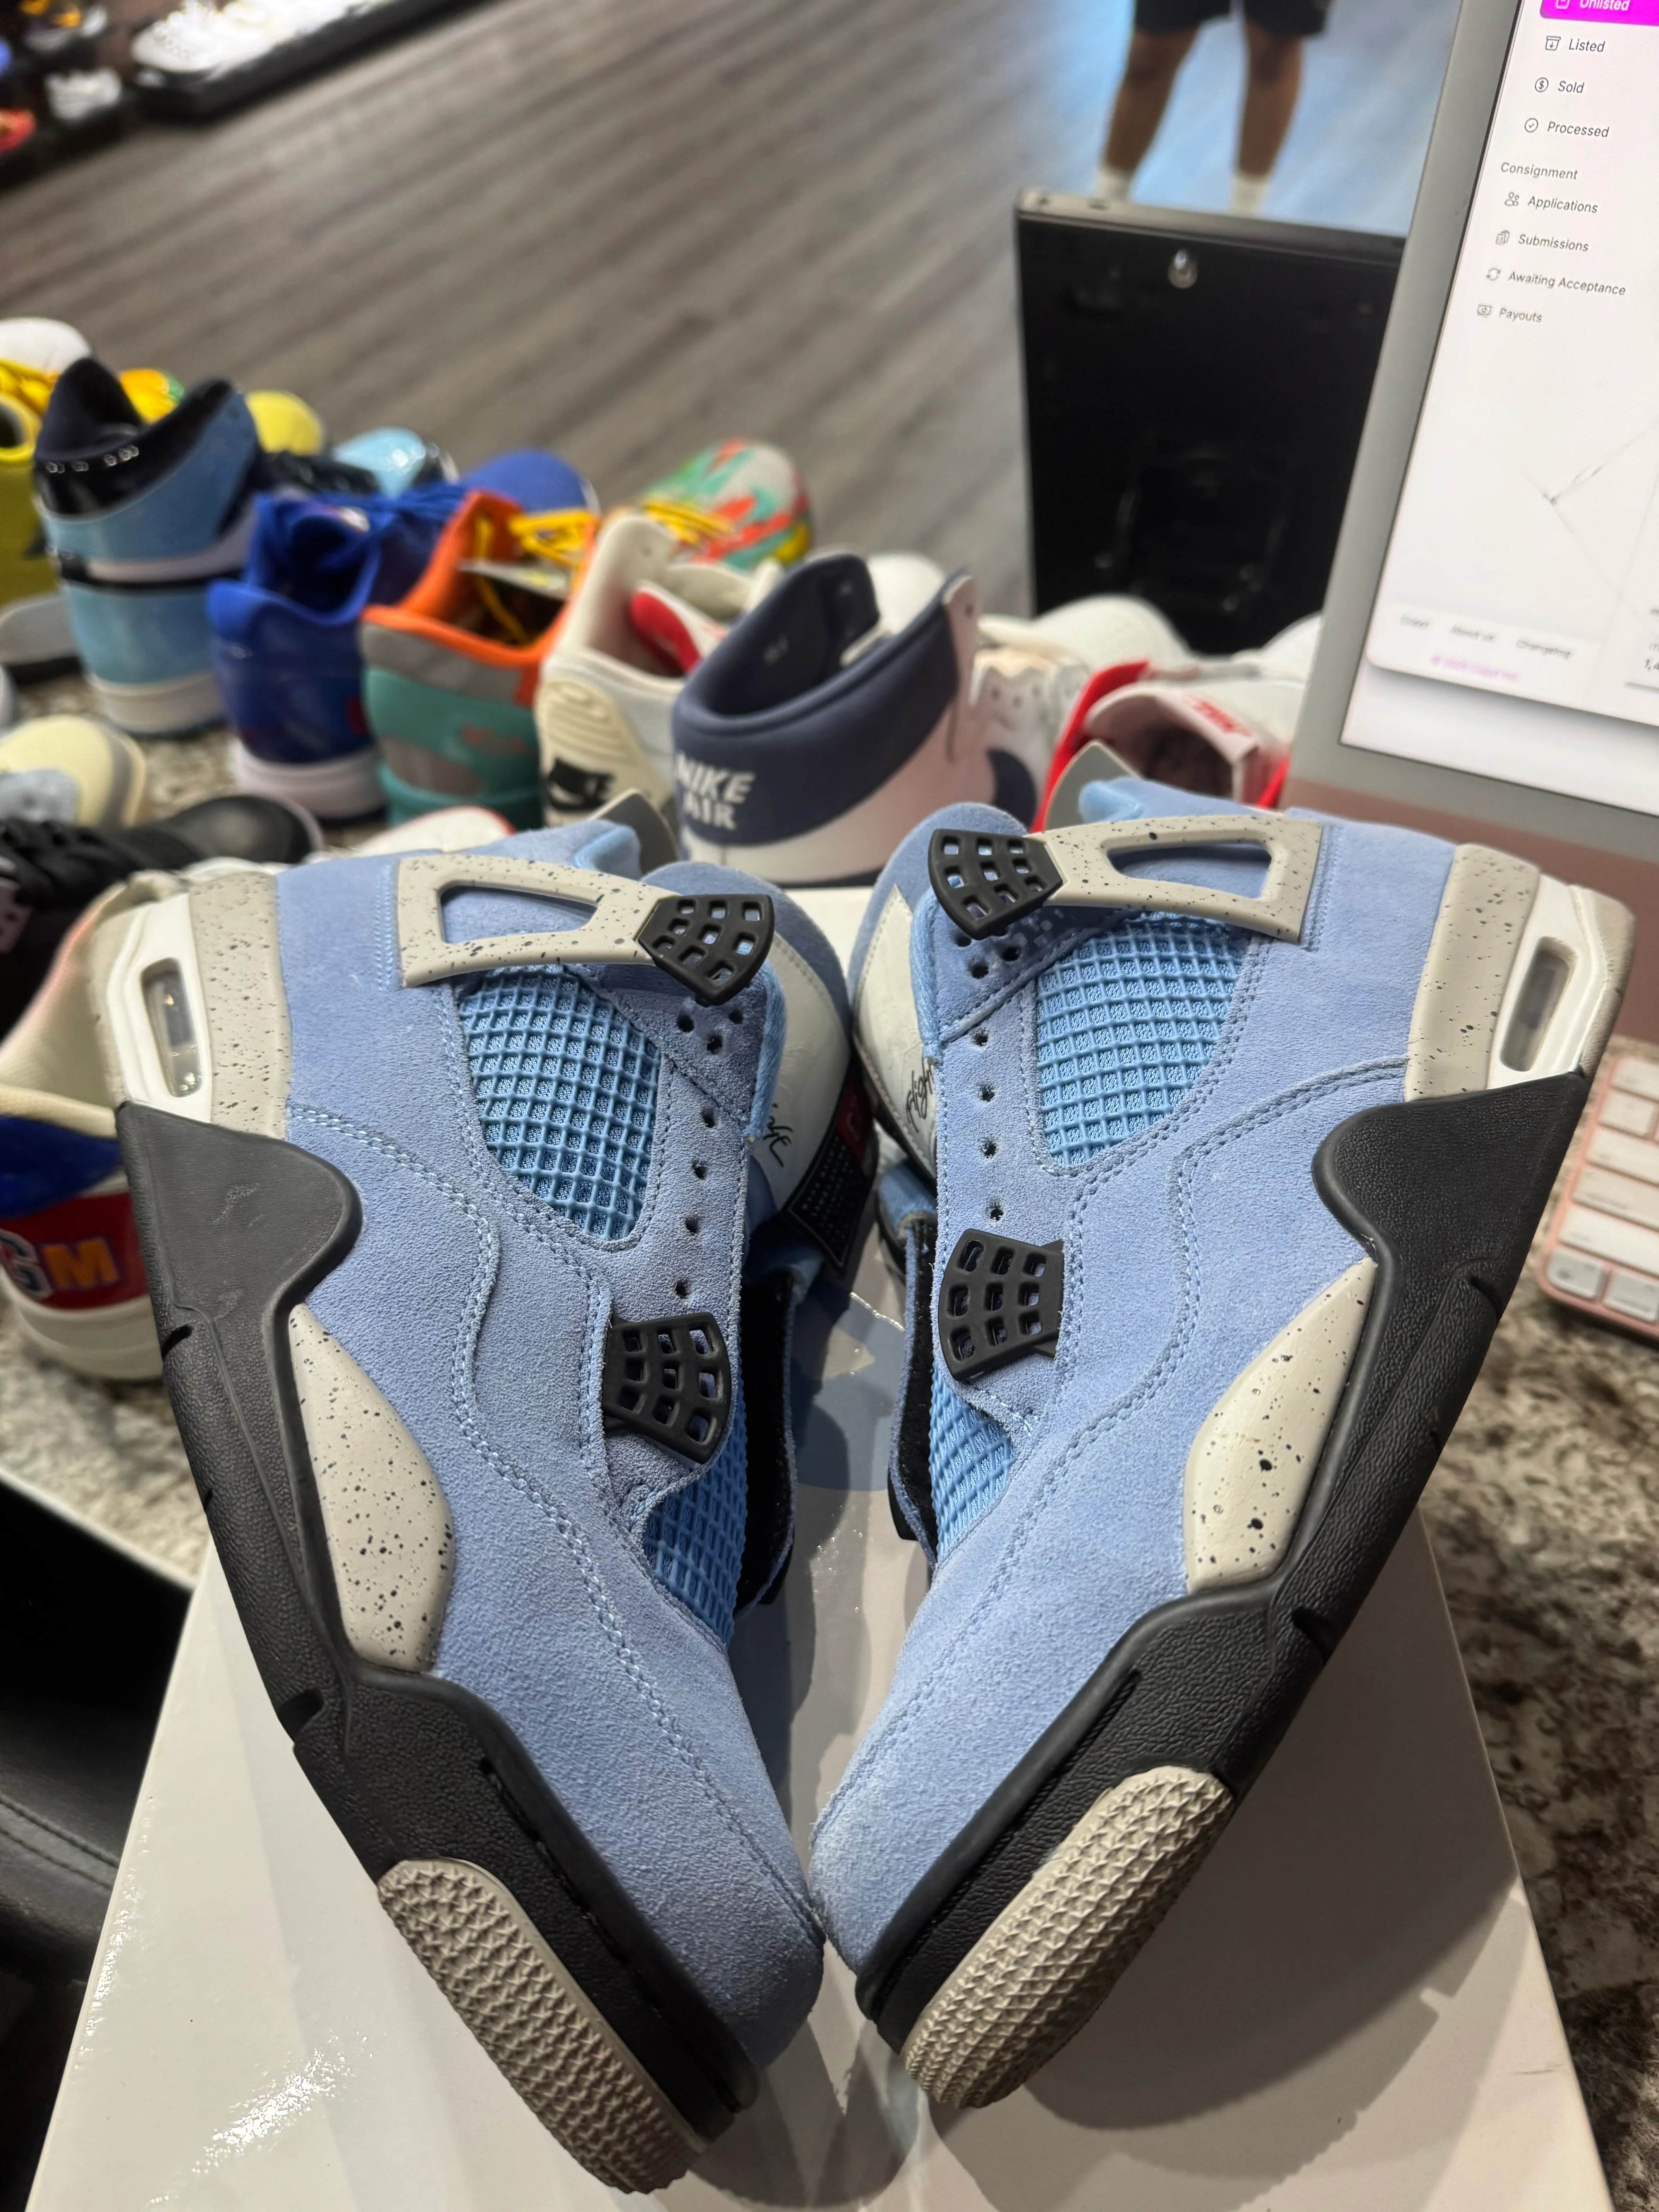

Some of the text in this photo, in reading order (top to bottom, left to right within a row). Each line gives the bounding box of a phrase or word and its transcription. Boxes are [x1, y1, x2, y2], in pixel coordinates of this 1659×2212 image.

[1580, 0, 1630, 11] Unlisted
[1568, 38, 1606, 52] Listed
[1558, 81, 1585, 93] Sold
[1547, 121, 1610, 137] Processed
[1501, 162, 1578, 179] Consignment
[1528, 196, 1598, 213] Applications
[1518, 234, 1589, 252] Submissions
[1508, 271, 1626, 295] Awaiting Acceptance
[1499, 308, 1542, 323] Payouts
[675, 750, 756, 804] NIKE
[682, 788, 737, 831] AIR
